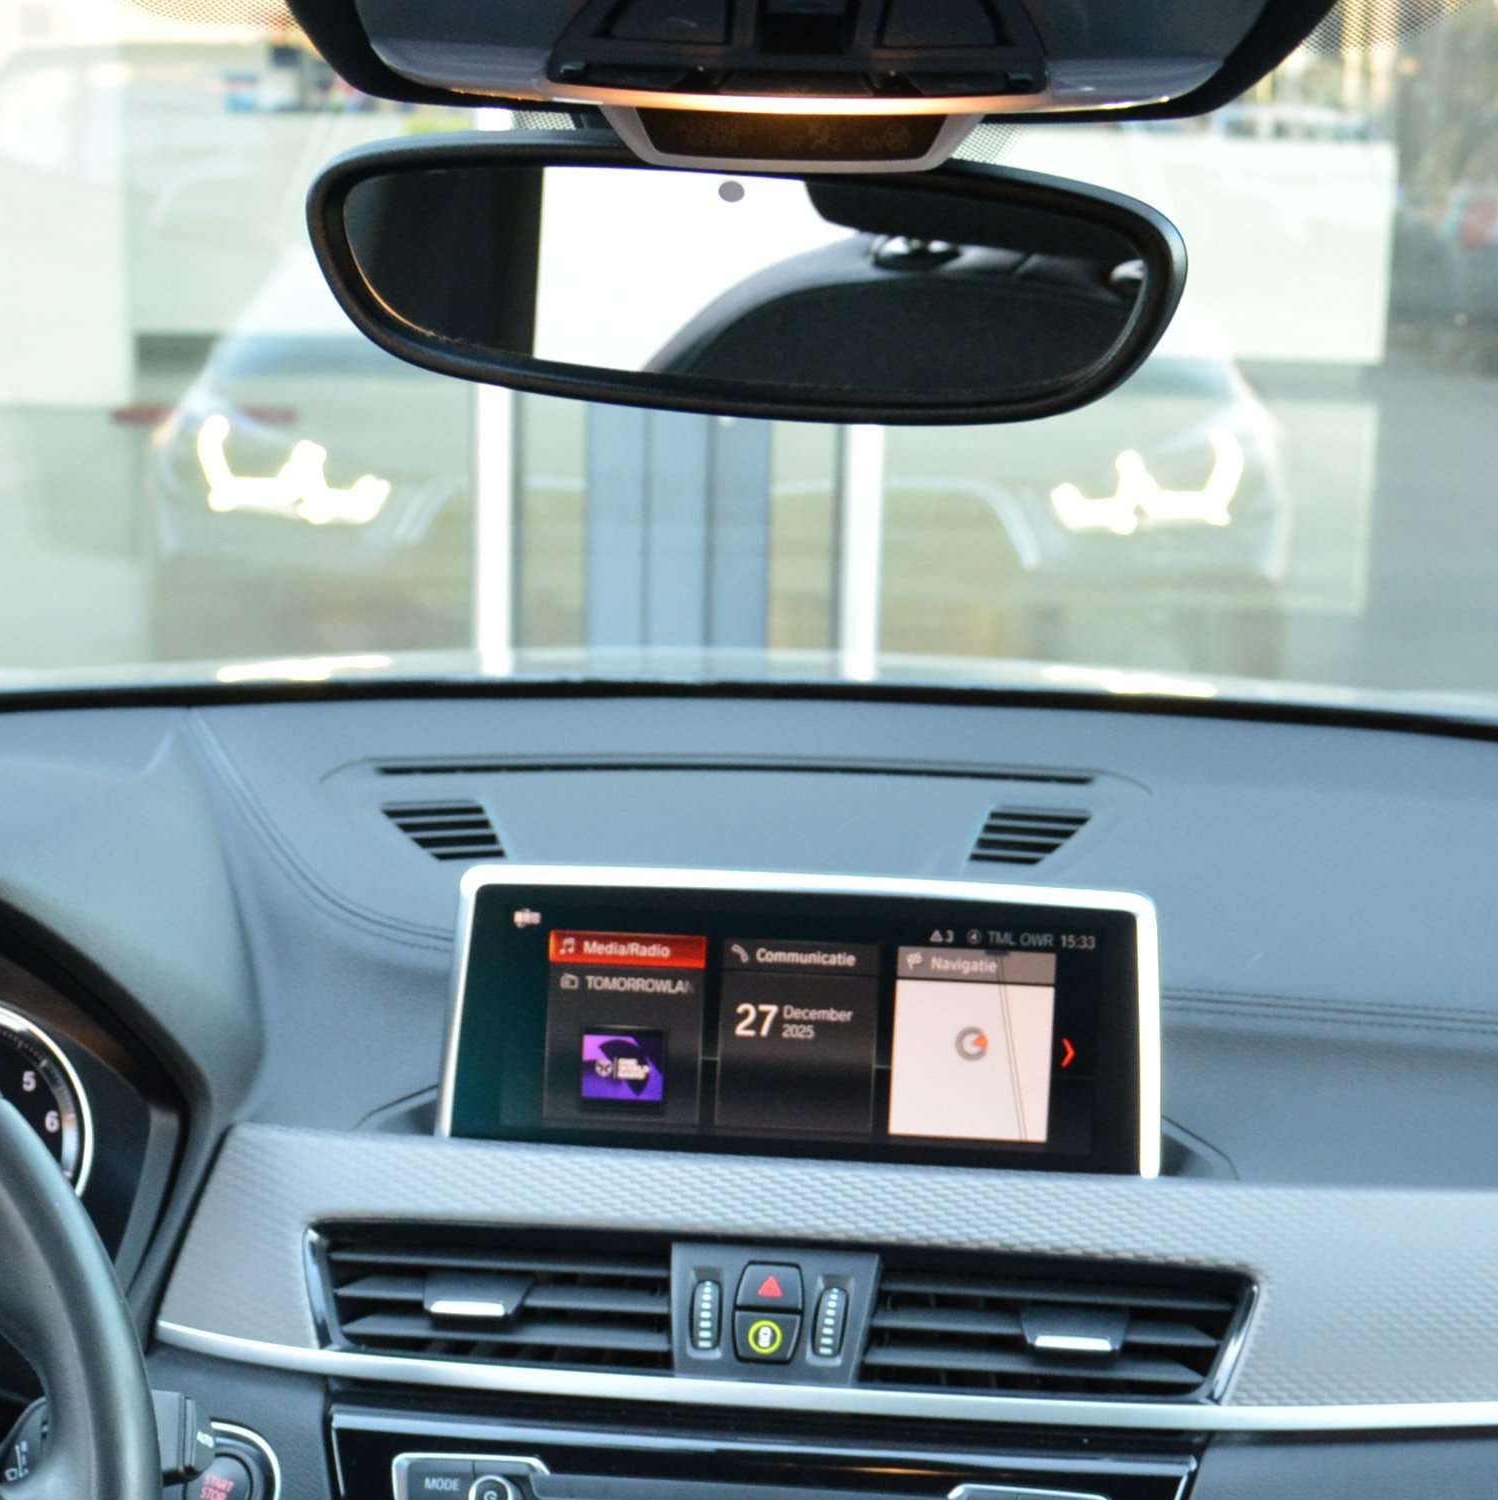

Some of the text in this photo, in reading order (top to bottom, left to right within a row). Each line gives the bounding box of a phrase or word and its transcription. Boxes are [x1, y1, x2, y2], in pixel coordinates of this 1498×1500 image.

[988, 930, 1054, 948] TML OWR
[1061, 934, 1096, 949] 15:33
[582, 940, 671, 959] Media/Radio
[755, 948, 856, 967] Communicatie
[930, 956, 998, 974] Navigatie
[734, 1003, 779, 1037] 27
[783, 1005, 853, 1022] December
[782, 1023, 815, 1039] 2025
[22, 1071, 36, 1091] 5
[44, 1111, 59, 1132] 6
[424, 1476, 460, 1492] MODE
